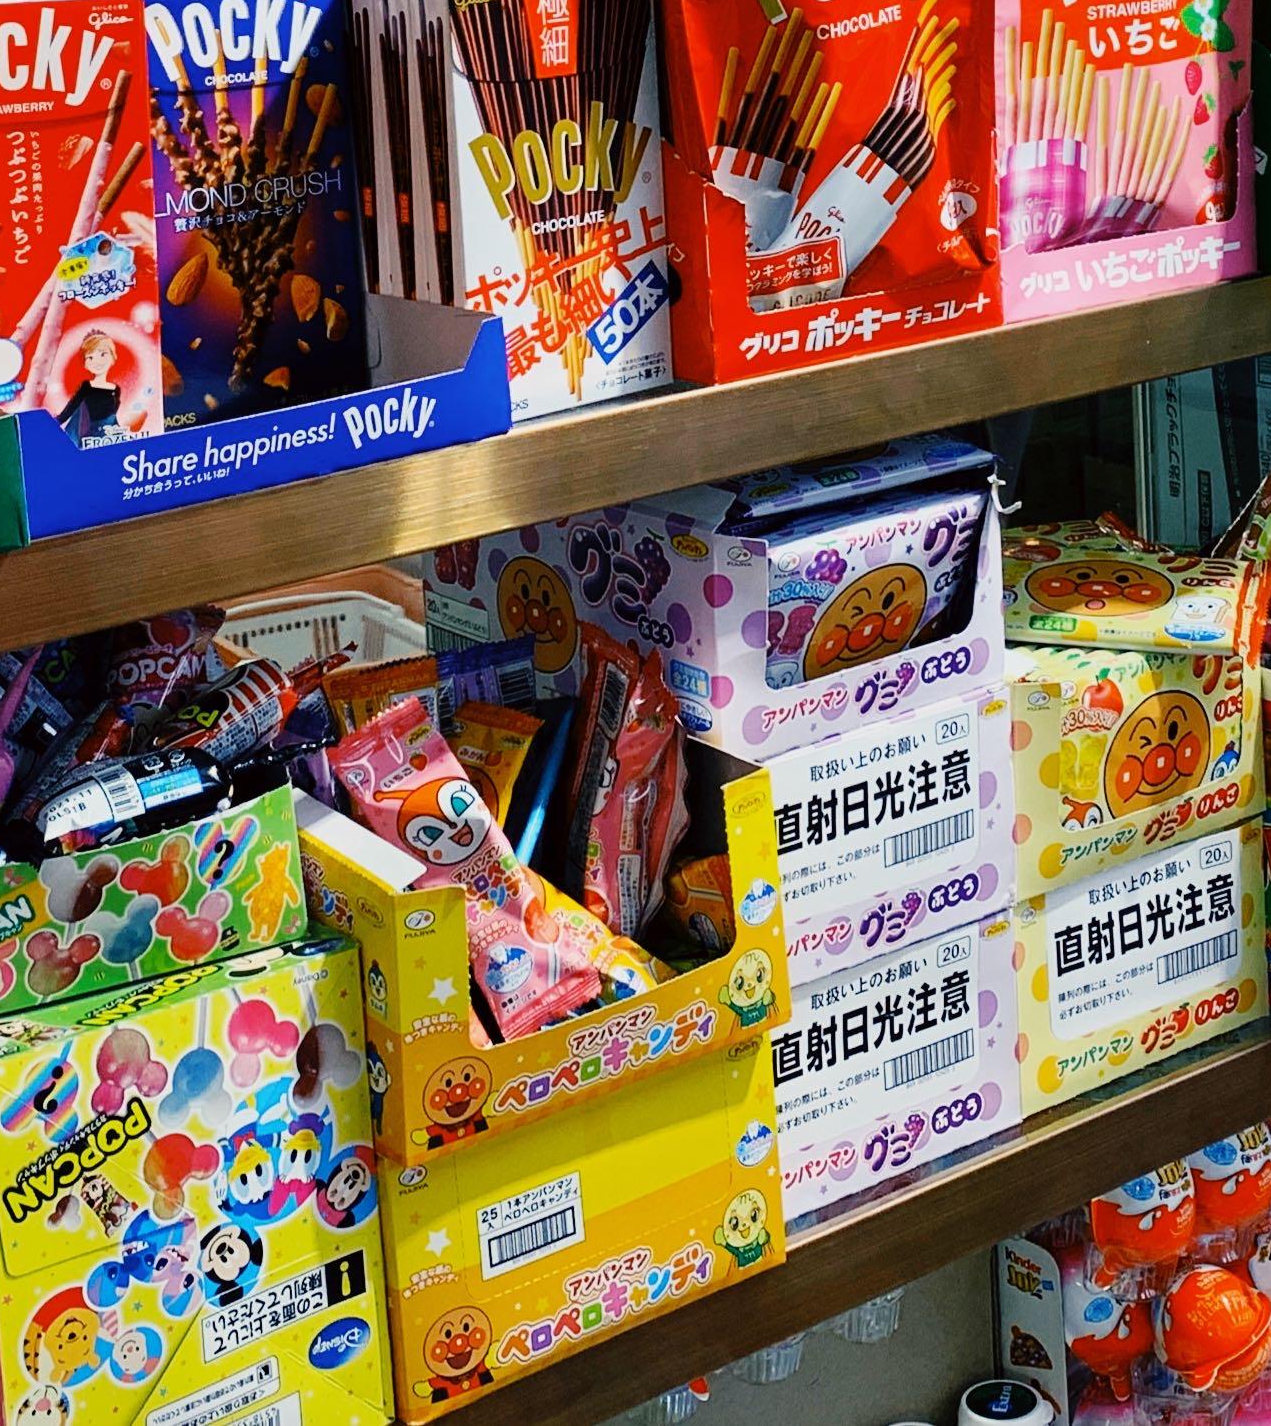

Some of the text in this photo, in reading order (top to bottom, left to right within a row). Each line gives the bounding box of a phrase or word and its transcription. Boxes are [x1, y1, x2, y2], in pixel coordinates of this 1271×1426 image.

[817, 5, 901, 40] CHOCOLATE
[1087, 20, 1182, 56] いちご
[205, 70, 268, 85] CHOCOLATE
[6, 130, 28, 265] つぶつぶいちご
[255, 170, 342, 204] CRUSH
[531, 209, 605, 235] CHOCOLATE
[594, 273, 663, 354] 50本
[1020, 271, 1069, 297] グリコ
[739, 293, 991, 361] グリコ ポッキー チョコレート
[123, 388, 431, 484] Share happiness! Pocky
[763, 646, 971, 730] アンパンマン グミ ぶどう
[810, 734, 926, 782] 取扱い上のお願い
[773, 749, 971, 856] 直射日光注意
[1061, 784, 1240, 864] アンパンマン りんご
[1055, 875, 1235, 977] 直射日光注意
[810, 956, 928, 1011] 取扱い上のお願い
[1194, 986, 1241, 1025] りんご
[495, 1003, 716, 1112] ペロペロキャンディ
[771, 972, 970, 1084] 直射日光注意
[3, 1098, 148, 1221] POPCAN
[481, 1208, 498, 1223] 25
[214, 1292, 323, 1355] この面を上にして
[497, 1244, 715, 1361] ペロペロキャンディ
